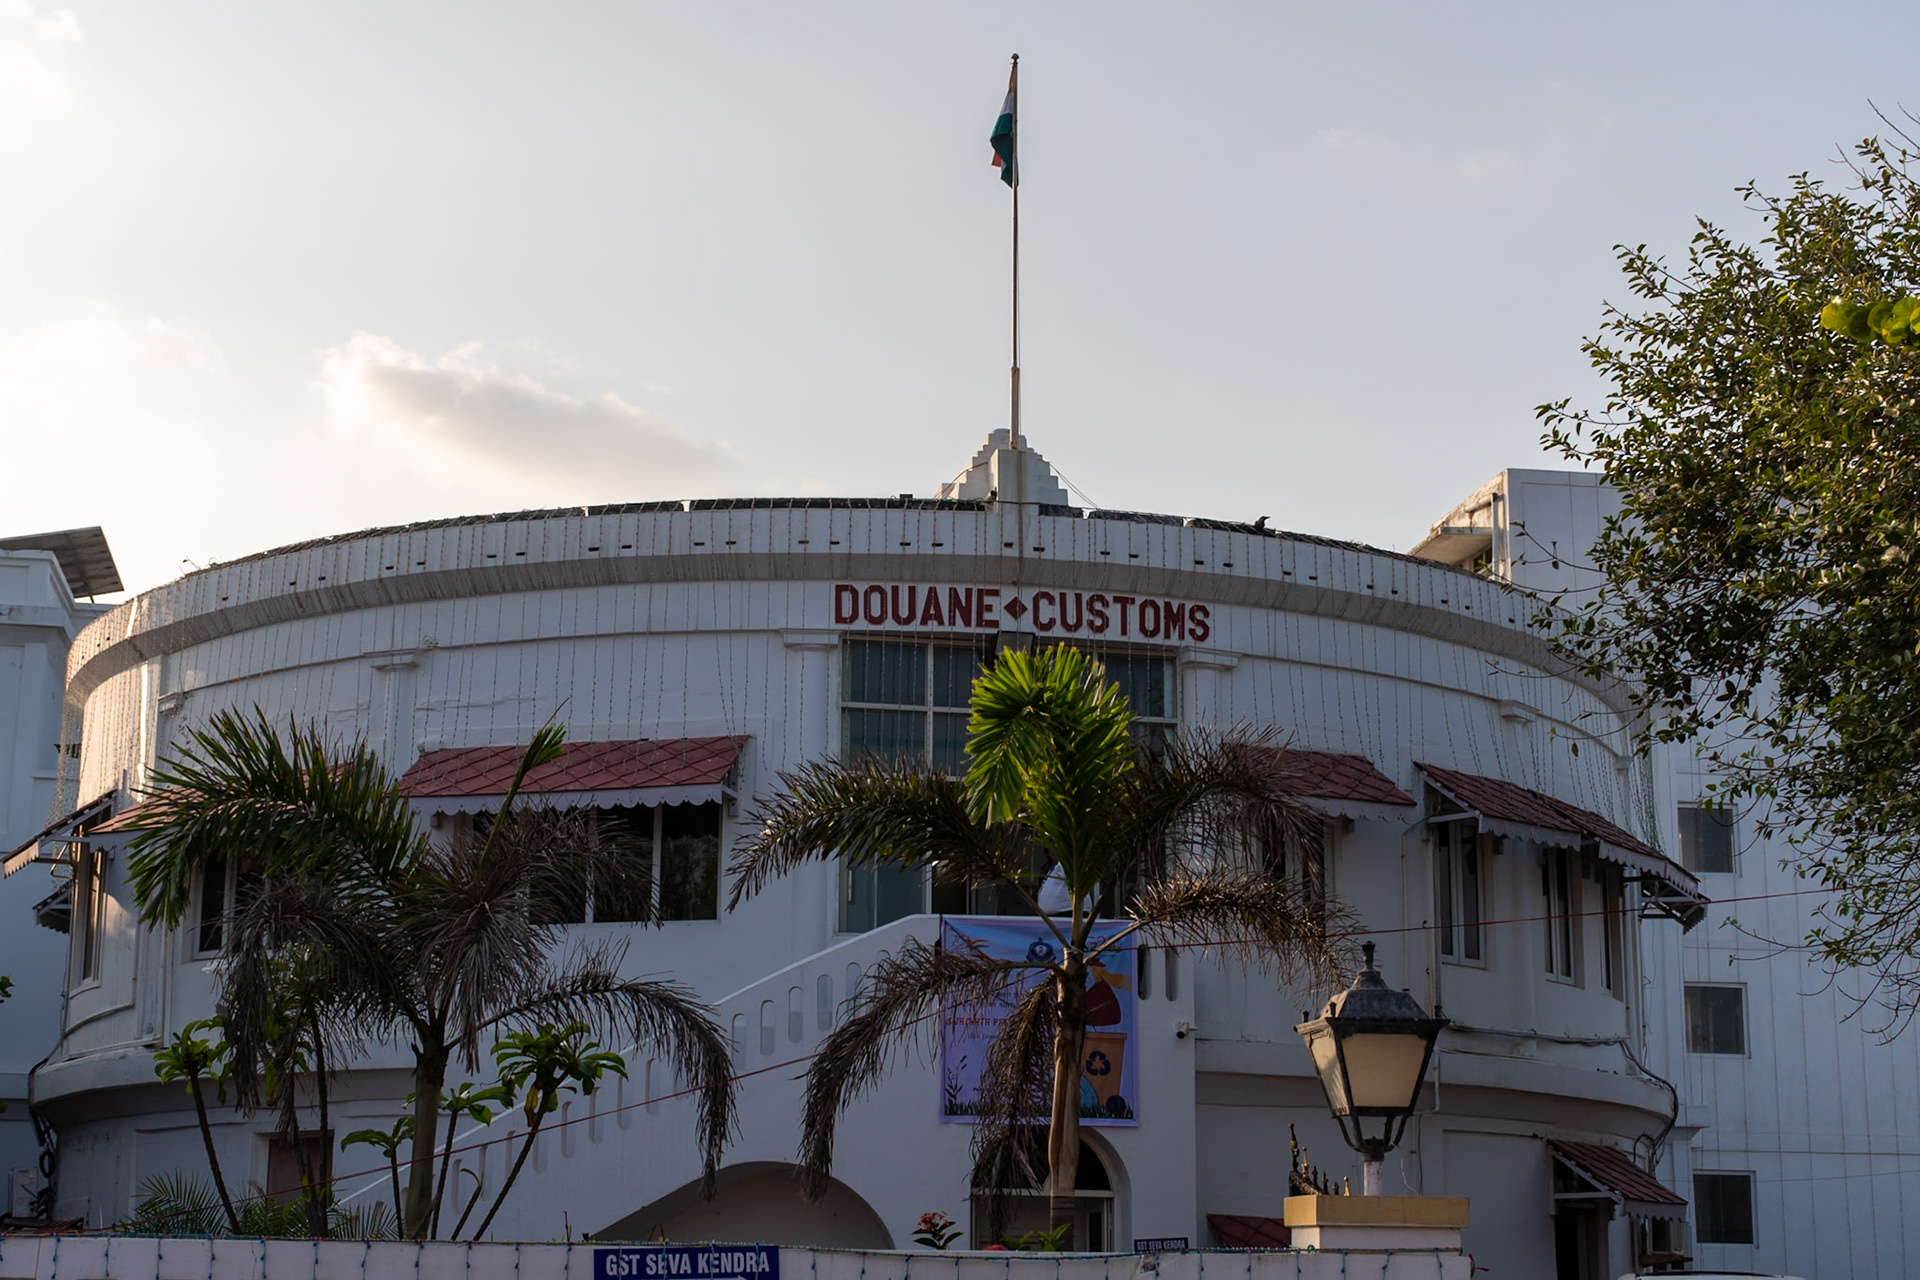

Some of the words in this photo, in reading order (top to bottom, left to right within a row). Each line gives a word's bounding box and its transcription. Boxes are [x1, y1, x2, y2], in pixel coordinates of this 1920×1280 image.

[834, 584, 1000, 628] DOUANE
[1032, 591, 1210, 642] CUSTOMS
[1137, 1241, 1147, 1251] GST
[1148, 1240, 1162, 1250] SEVA
[1163, 1239, 1186, 1249] KENDRA
[605, 1254, 640, 1276] GST
[646, 1252, 692, 1275] SEVA
[697, 1251, 770, 1274] KENDRA
